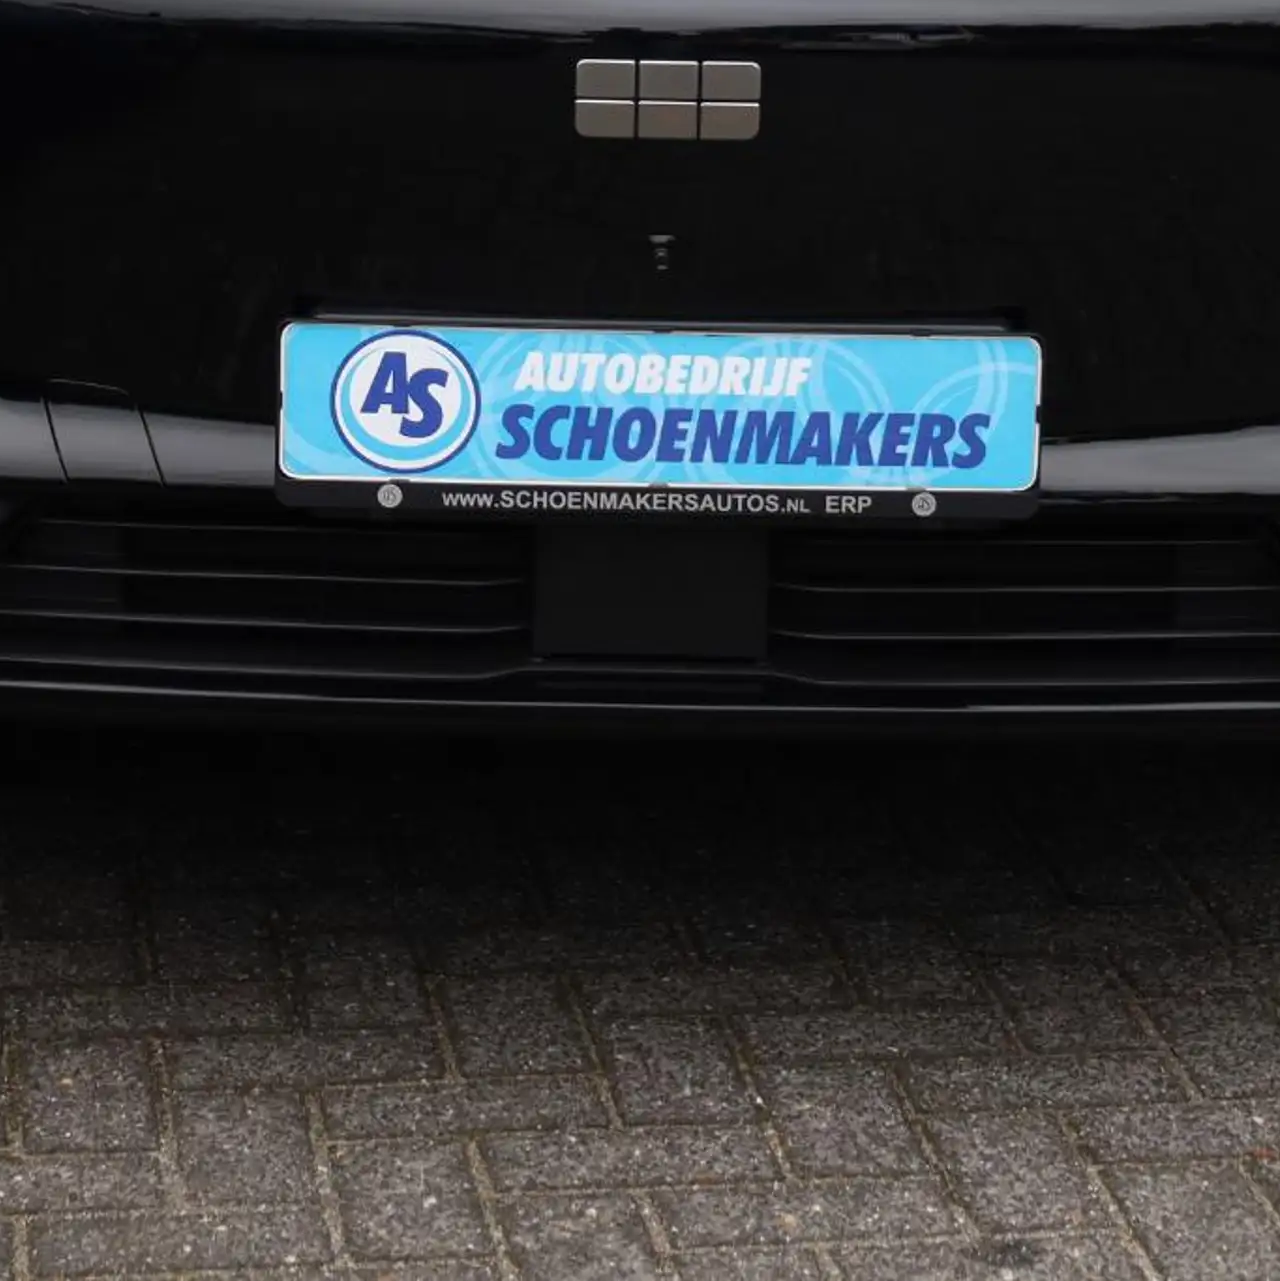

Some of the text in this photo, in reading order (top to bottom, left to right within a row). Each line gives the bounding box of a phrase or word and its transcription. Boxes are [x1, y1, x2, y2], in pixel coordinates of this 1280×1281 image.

[360, 351, 450, 438] AS
[513, 351, 813, 396] AUTOBEDRIJF
[495, 403, 991, 469] SCHOENMAKERS
[824, 495, 872, 514] ERP
